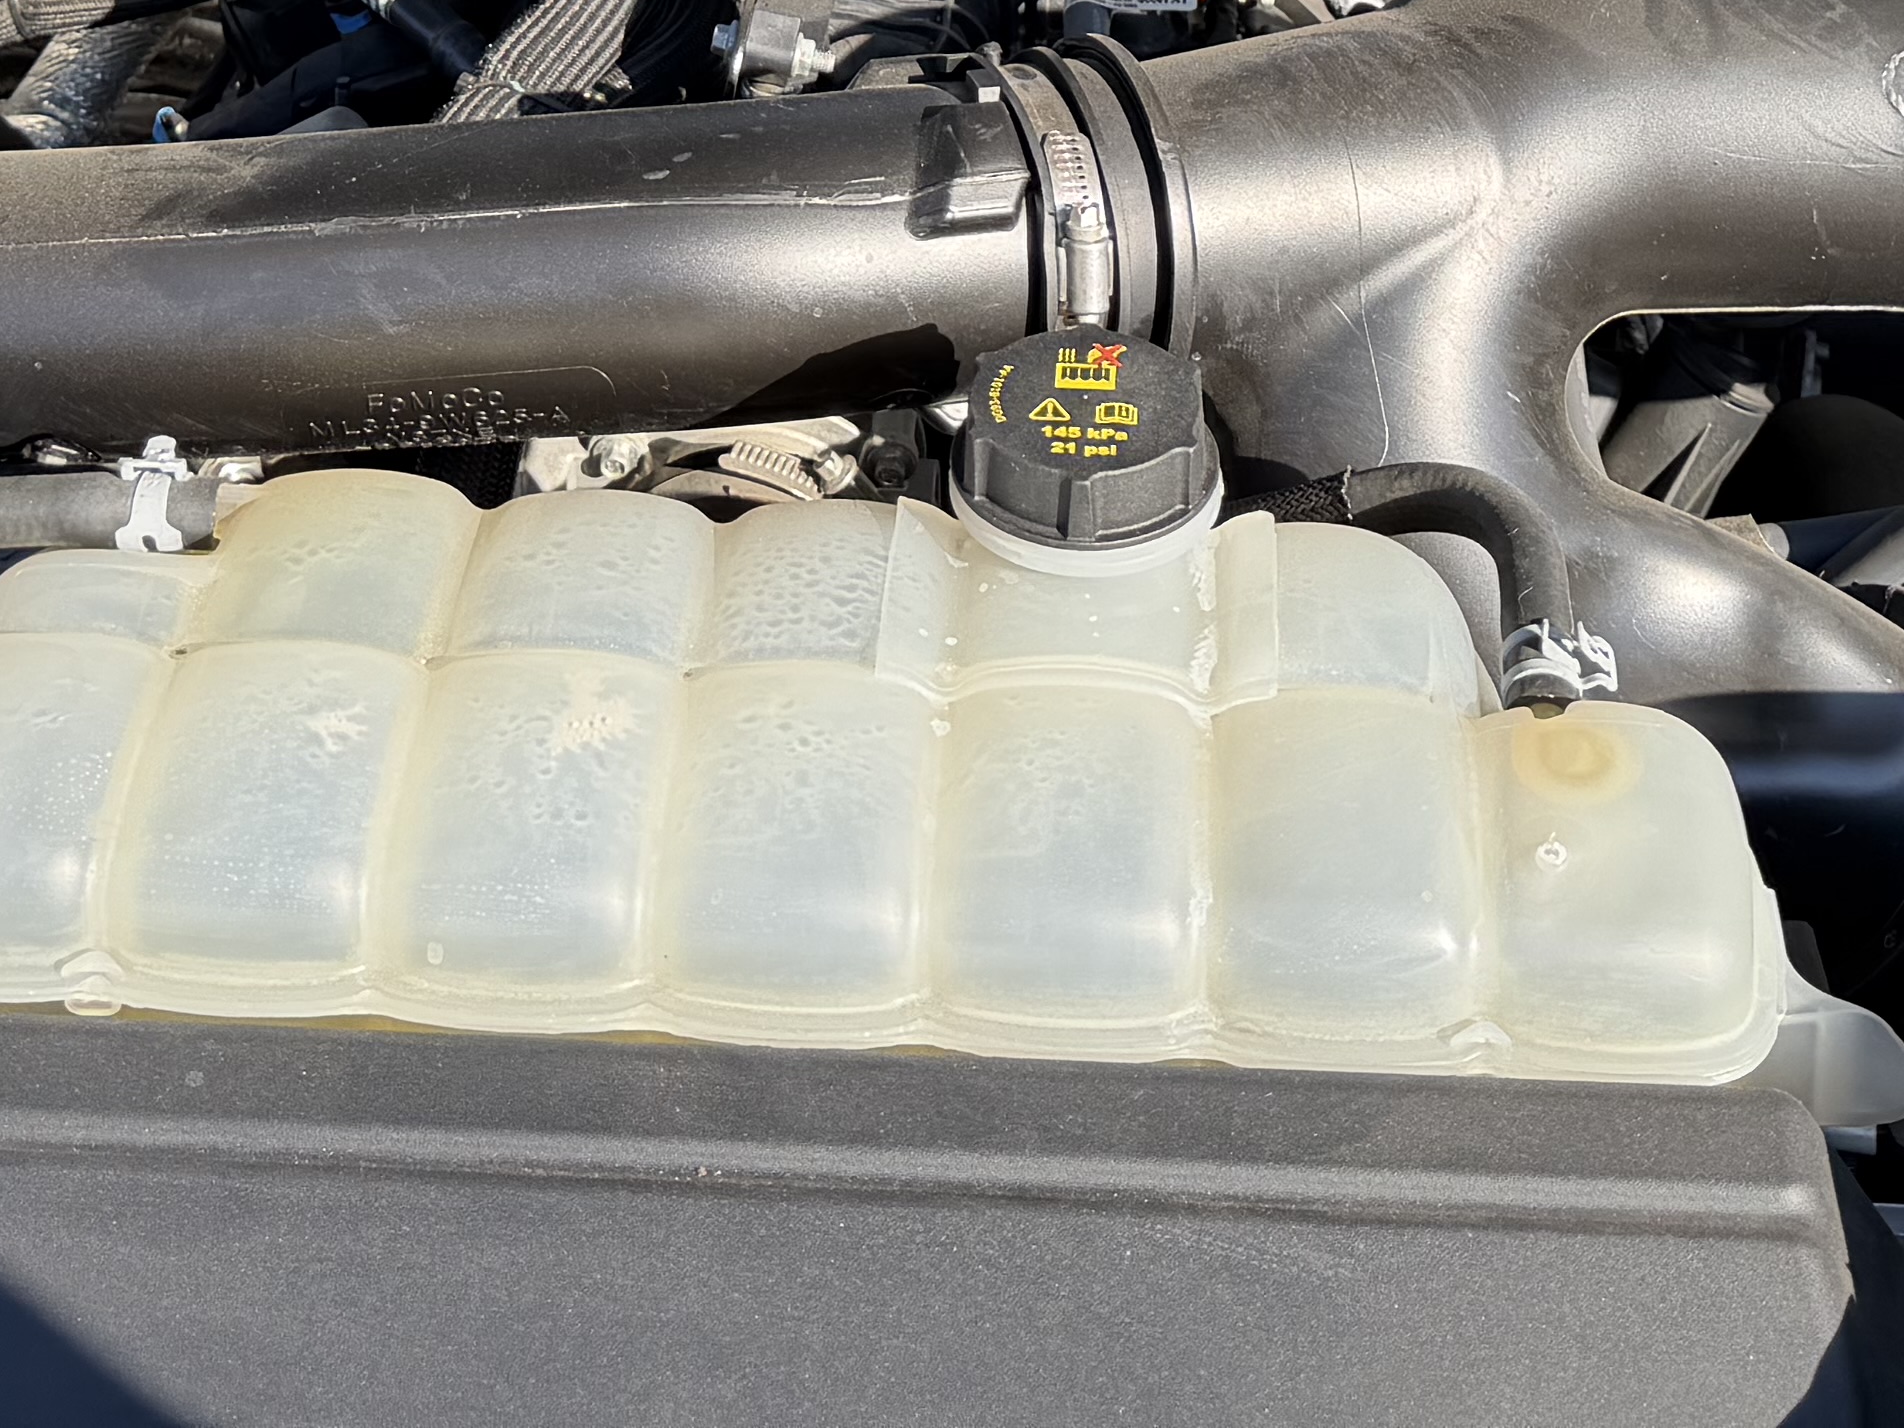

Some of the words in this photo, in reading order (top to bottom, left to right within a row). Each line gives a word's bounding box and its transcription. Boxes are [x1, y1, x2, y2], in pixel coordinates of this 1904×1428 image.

[1041, 425, 1081, 439] 145
[1086, 427, 1129, 442] kPa
[1049, 441, 1076, 455] 21
[1083, 443, 1117, 458] psi
